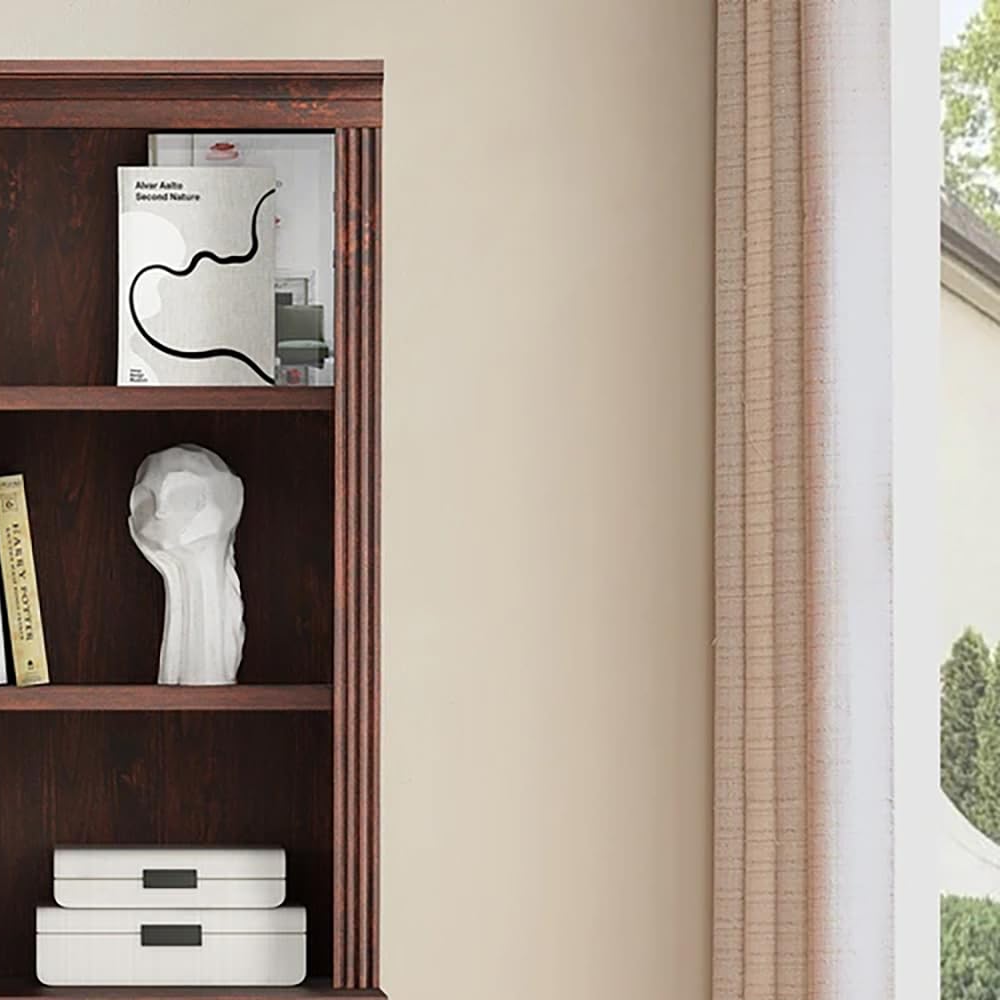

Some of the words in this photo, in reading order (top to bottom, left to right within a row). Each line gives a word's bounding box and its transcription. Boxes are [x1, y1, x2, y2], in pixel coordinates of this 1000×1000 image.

[135, 181, 157, 190] Alvar
[160, 181, 183, 190] Aalto
[135, 192, 168, 201] Second
[170, 192, 200, 201] Nature
